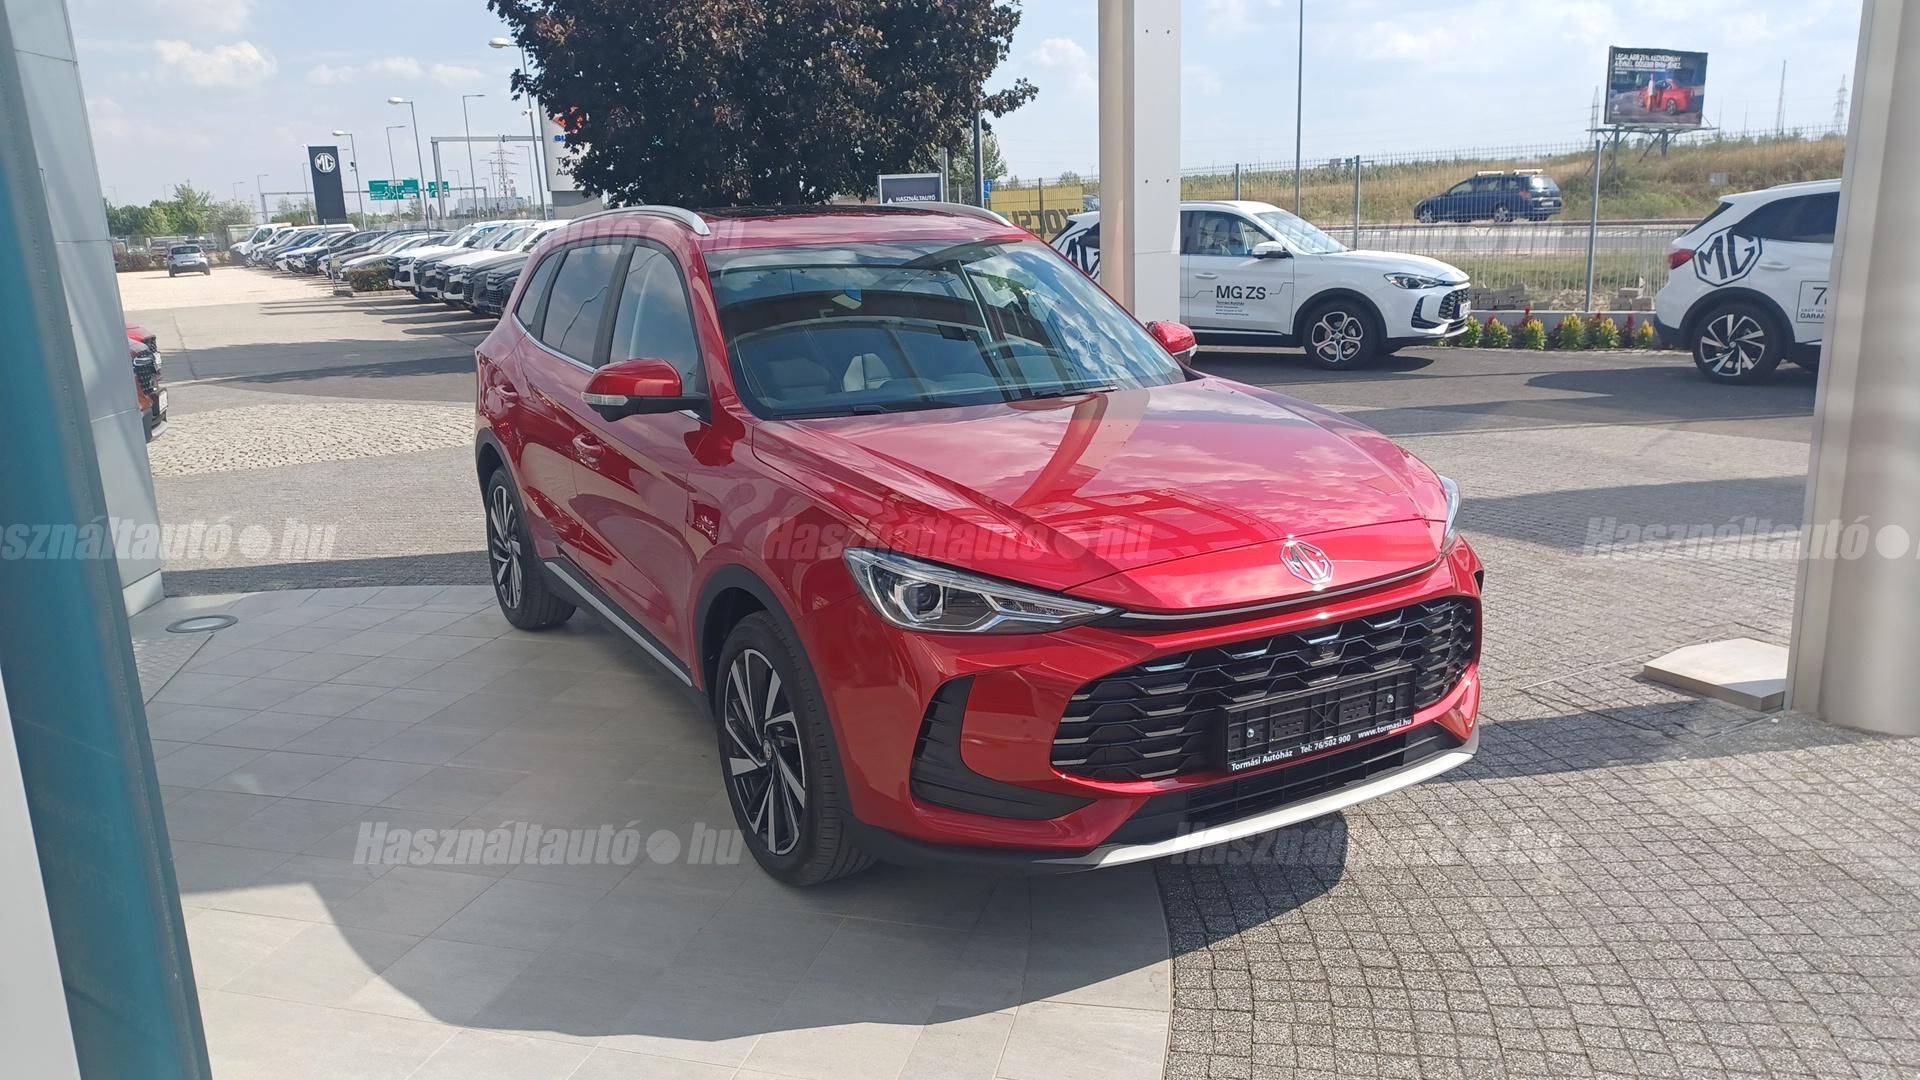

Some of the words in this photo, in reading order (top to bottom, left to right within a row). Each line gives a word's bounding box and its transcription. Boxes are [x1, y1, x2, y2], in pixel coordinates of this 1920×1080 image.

[316, 154, 335, 172] MG
[1698, 228, 1757, 280] MG
[1216, 285, 1242, 299] MG
[1245, 286, 1266, 300] ZS
[1281, 541, 1333, 584] MG
[1231, 757, 1261, 772] Tormási
[1262, 750, 1294, 764] Autóház
[1300, 745, 1313, 754] Tel:
[1314, 739, 1337, 751] 76/502
[1338, 734, 1351, 745] 900
[1357, 717, 1412, 739] www.tormasi.hu
